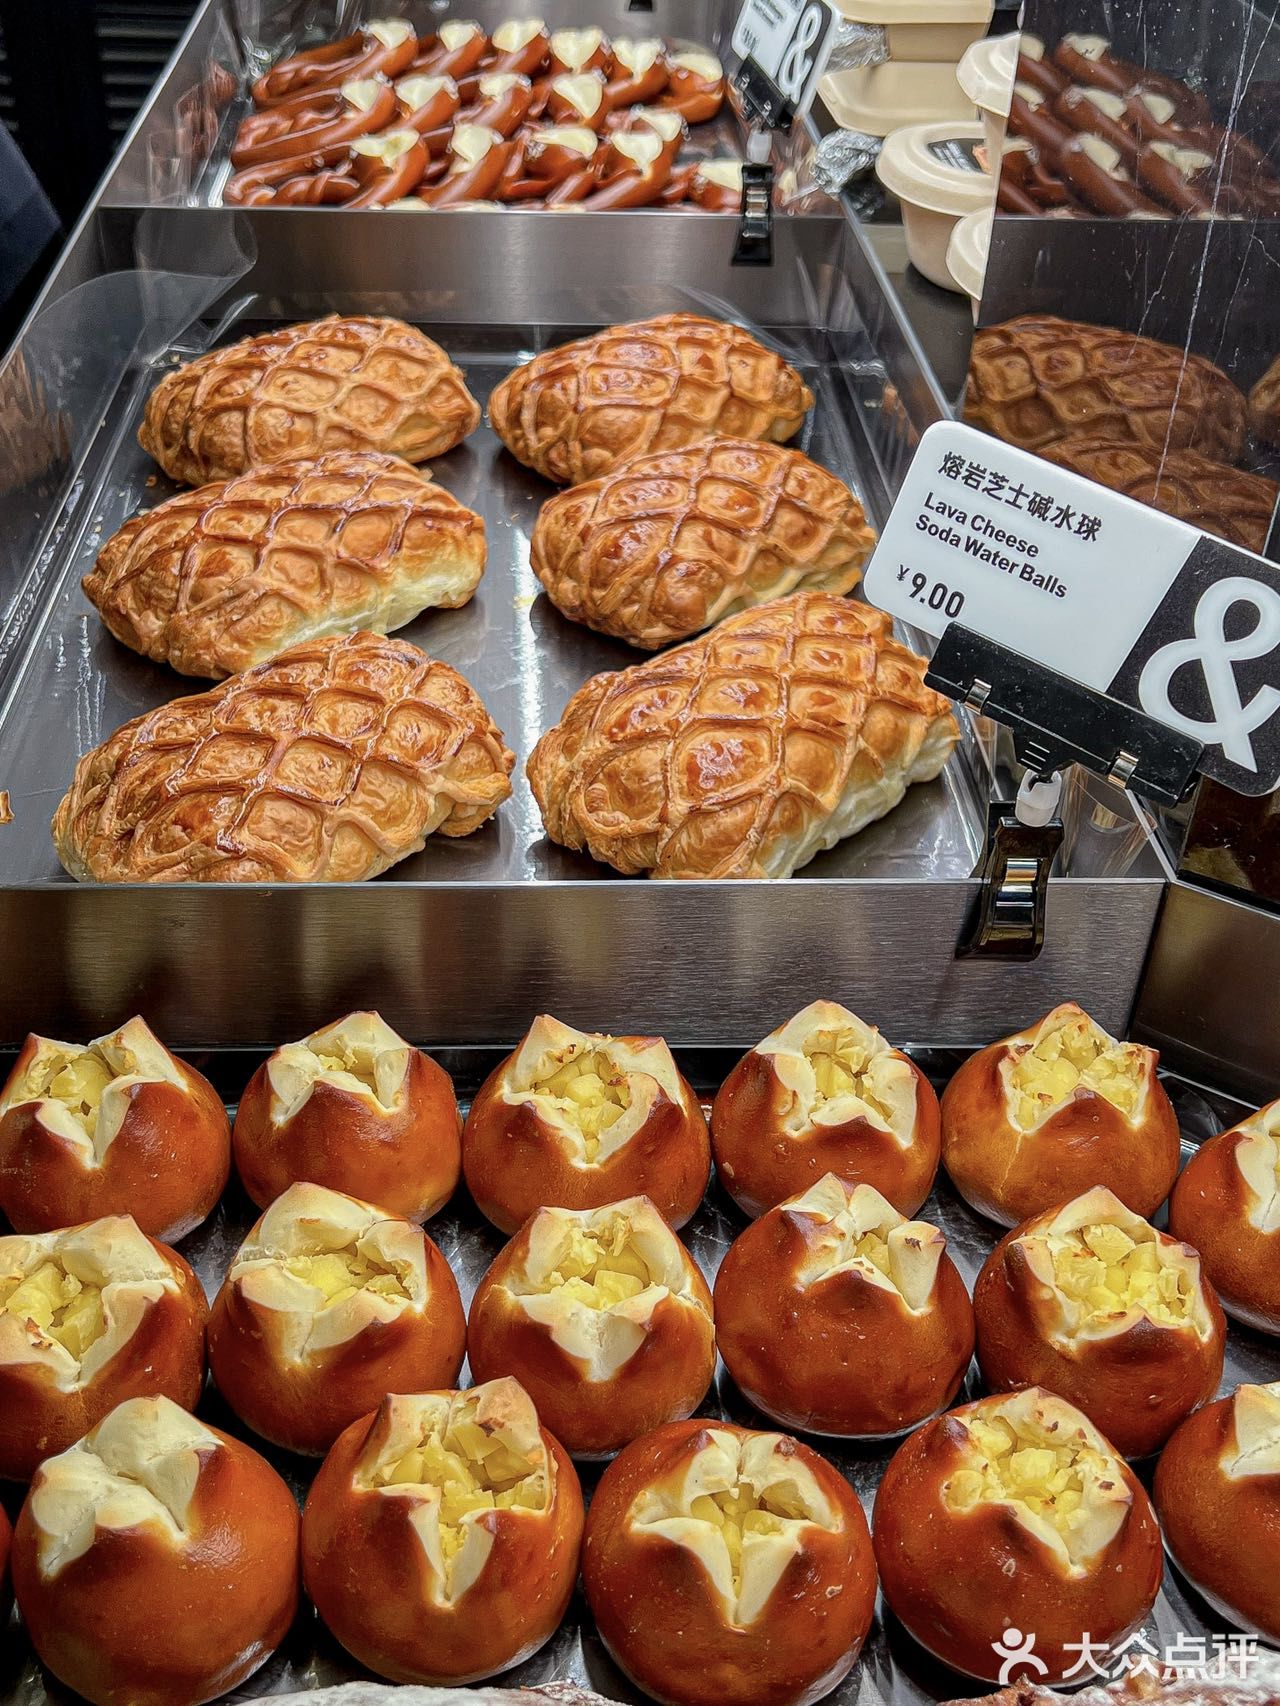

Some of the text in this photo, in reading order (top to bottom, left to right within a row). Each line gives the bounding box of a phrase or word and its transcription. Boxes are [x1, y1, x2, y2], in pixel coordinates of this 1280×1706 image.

[924, 492, 1039, 557] Lava Cheese
[938, 452, 1102, 542] 熔岩芝士碱水球
[915, 515, 1068, 598] Soda Water Balls
[1139, 577, 1280, 772] &
